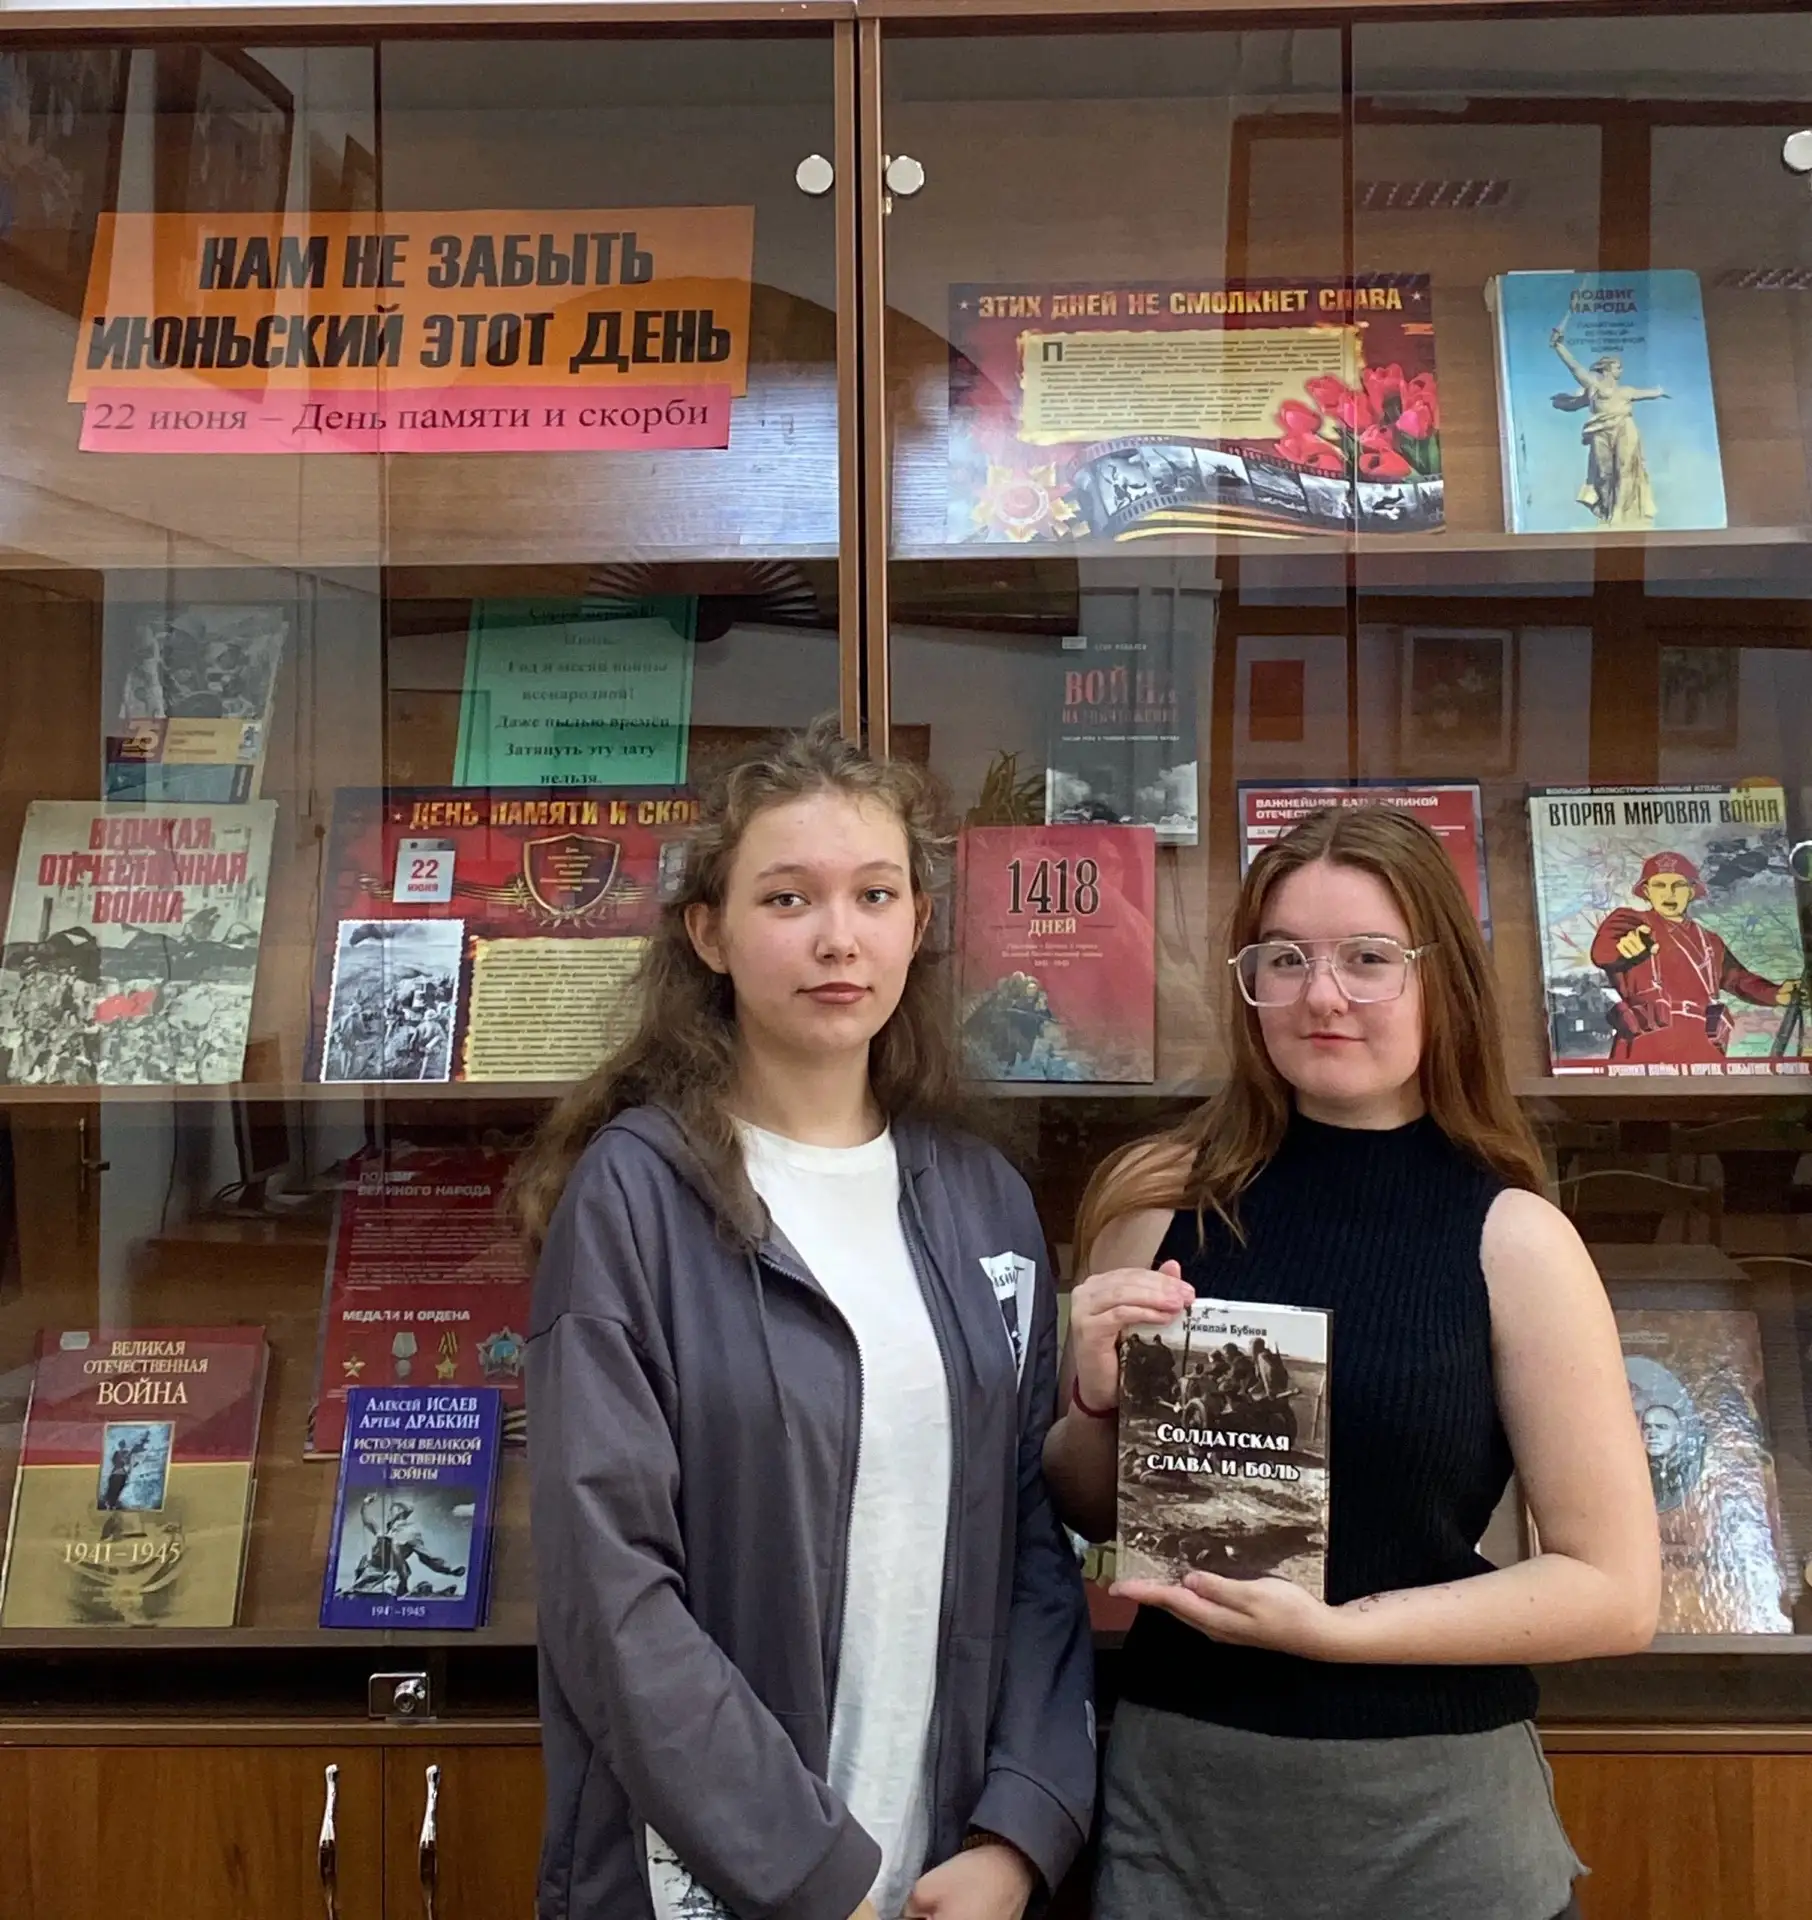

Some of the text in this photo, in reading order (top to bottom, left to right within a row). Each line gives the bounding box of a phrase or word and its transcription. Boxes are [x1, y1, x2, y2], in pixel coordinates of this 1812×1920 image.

[199, 231, 654, 290] НАМ НЕ ЗАБЫТЬ
[978, 294, 1042, 319] ЭТИХ
[1050, 290, 1117, 321] ДНЕЙ
[1128, 292, 1160, 317] НЕ
[1169, 288, 1310, 317] СМОЛКНЕТ
[86, 303, 732, 374] ИЮНЬСКИЙ ЭТОТ ДЕНЬ
[92, 402, 135, 431] 22
[149, 407, 248, 432] июня
[292, 401, 387, 434] День
[398, 405, 531, 431] памяти
[544, 405, 565, 428] и
[583, 398, 710, 434] скорби
[408, 801, 480, 830] ДЕНЬ
[489, 800, 599, 826] ПАМЯТИ
[609, 800, 628, 825] И
[1255, 809, 1314, 820] ОТЕЧЕСТ
[1549, 793, 1781, 827] ВТОРАЯ МИРОВАЯ ВОЙНА
[89, 817, 214, 850] ВЕЛИКАЯ
[410, 859, 439, 880] 22
[407, 882, 440, 893] ИЮНЯ
[1006, 857, 1100, 916] 1418
[92, 890, 184, 924] ВОЙНА
[1027, 917, 1077, 937] ДНЕЙ
[436, 1185, 492, 1198] НАРОДА
[342, 1310, 471, 1323] МЕДАЛИ И ОРДЕНА
[1183, 1320, 1268, 1338] Николай Бубнов
[111, 1340, 186, 1356] ВЕЛИКАЯ
[83, 1358, 208, 1374] ОТЕЧЕСТВЕННАЯ
[96, 1377, 189, 1406] ВОЙНА
[426, 1397, 478, 1412] ИСАЕВ
[404, 1414, 481, 1431] ДРАБКИН
[418, 1436, 482, 1451] ВЕЛИКОЙ
[358, 1452, 472, 1466] ОТЕЧЕСТВЕННОЙ
[1147, 1455, 1301, 1482] СЛАВА И БОЛЬ
